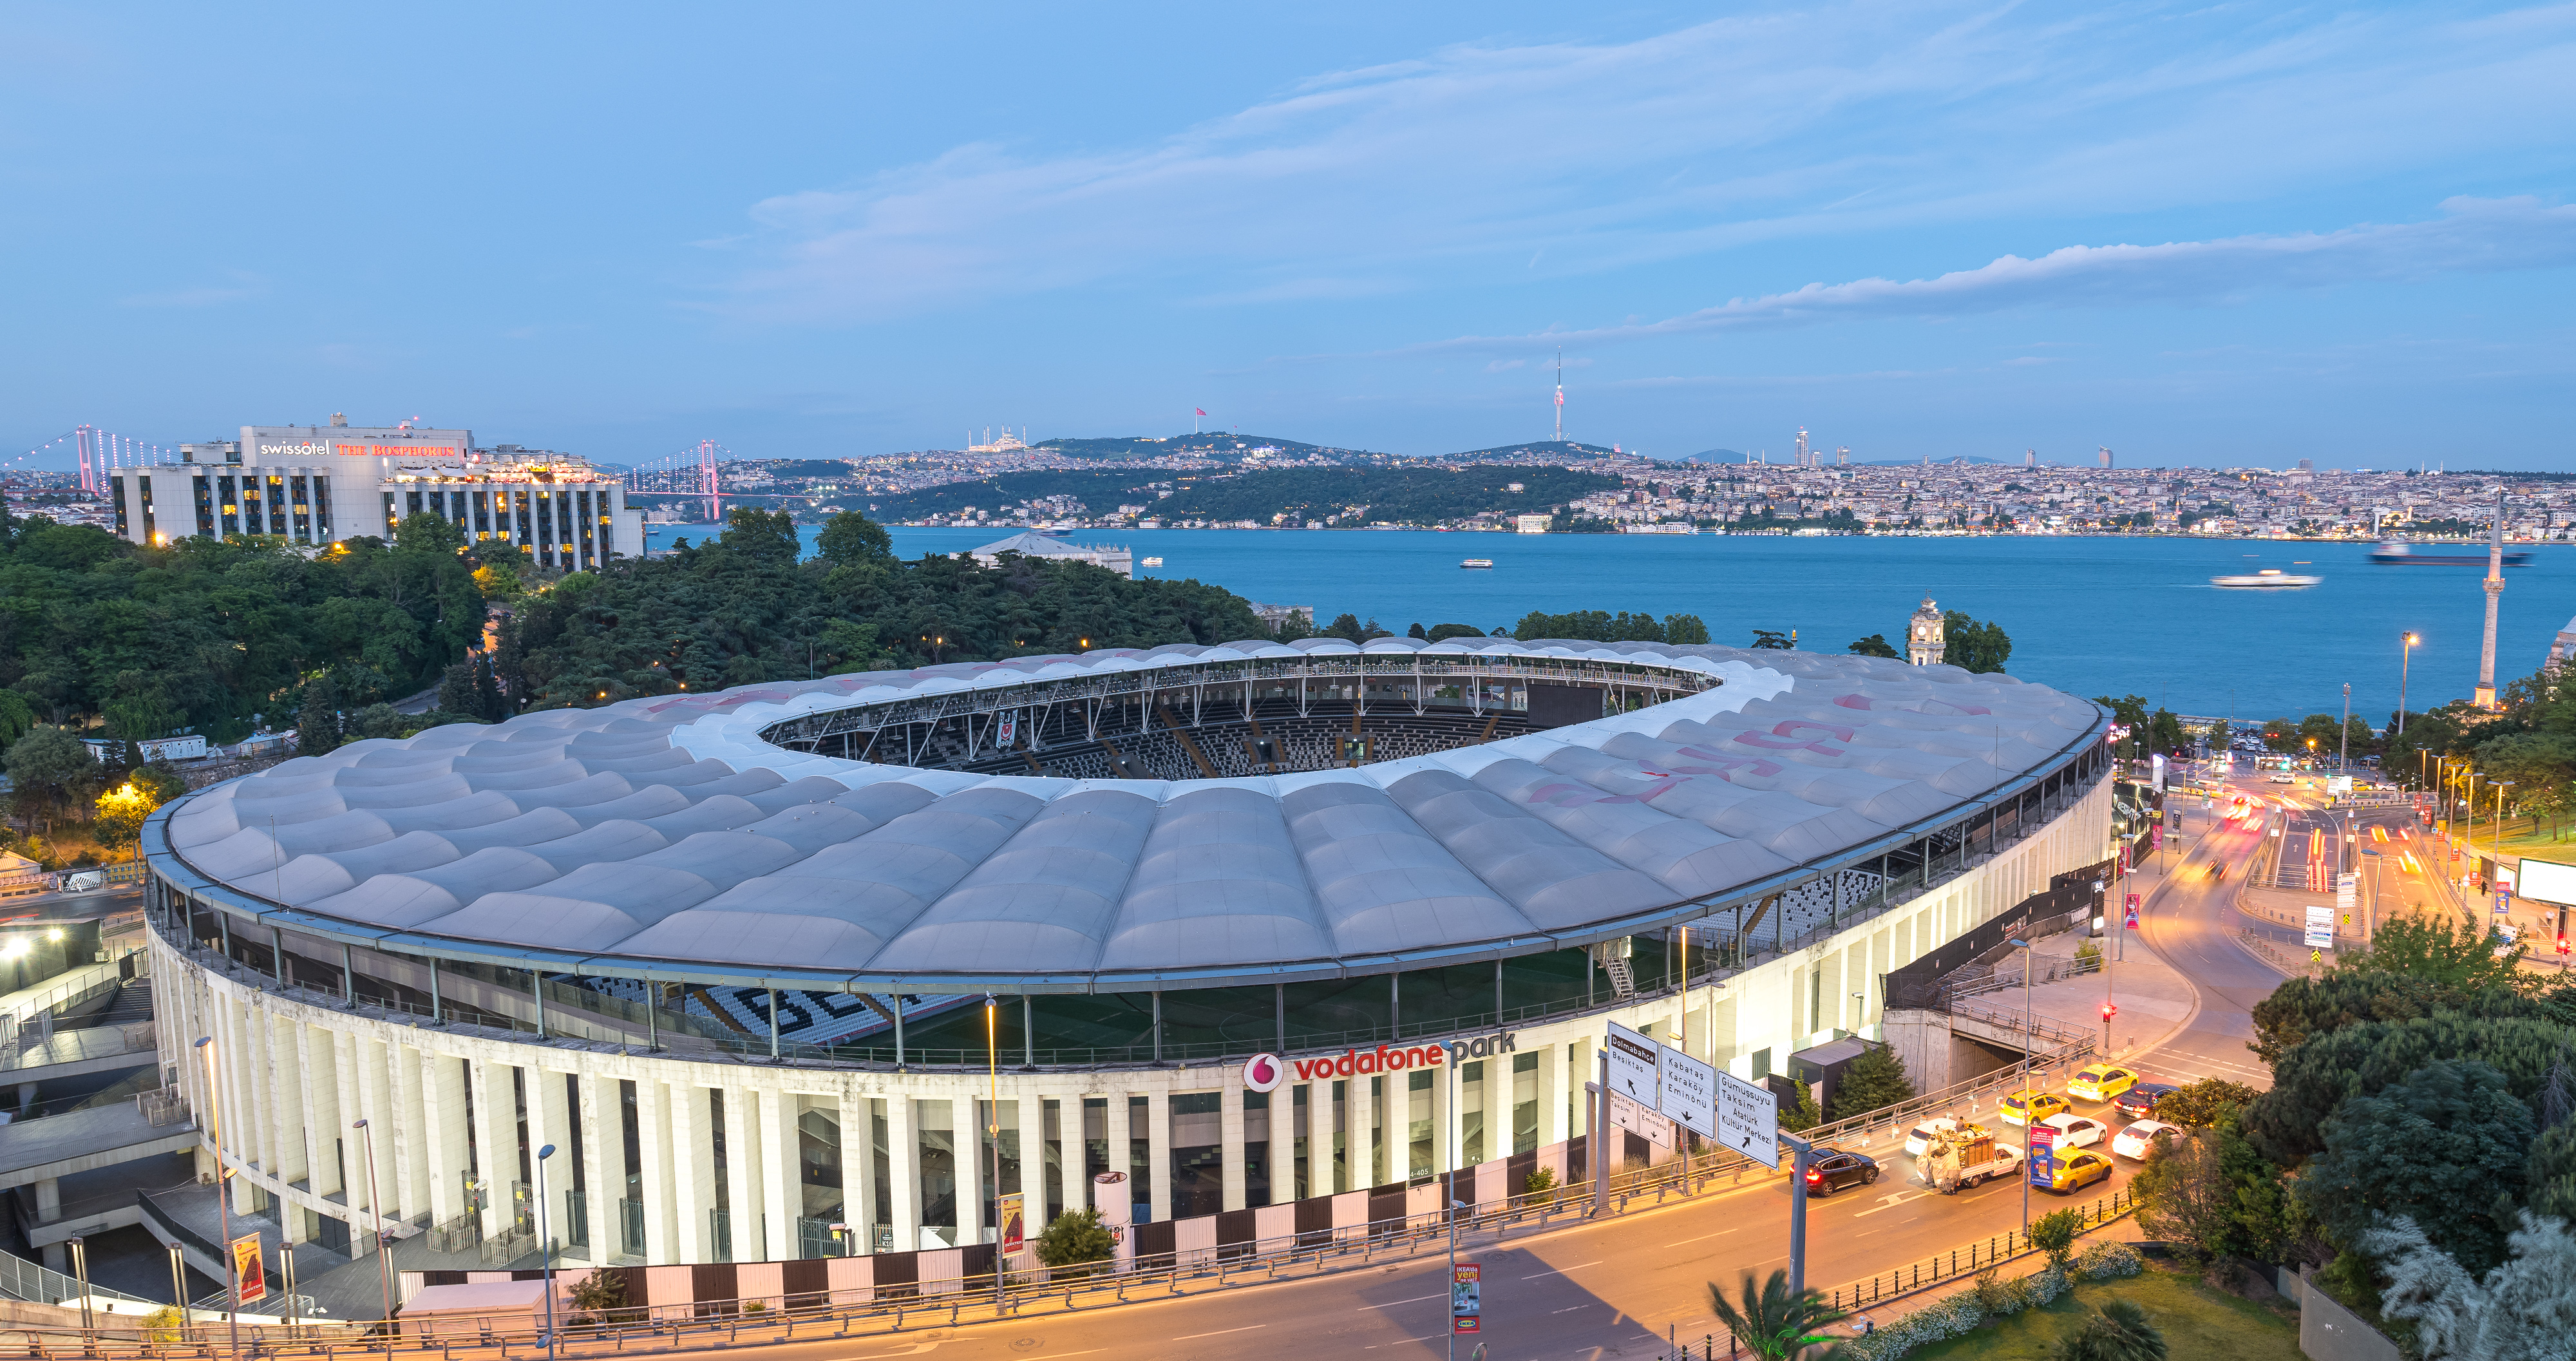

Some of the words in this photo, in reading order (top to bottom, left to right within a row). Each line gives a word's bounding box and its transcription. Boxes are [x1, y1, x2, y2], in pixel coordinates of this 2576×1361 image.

[261, 439, 330, 455] swissôtel
[336, 444, 366, 455] THE
[372, 444, 455, 457] BOSPHORUS
[999, 712, 1017, 723] BJK
[998, 739, 1014, 747] 1903
[1294, 1044, 1443, 1080] vodafone
[1452, 1028, 1516, 1069] park
[1613, 1036, 1654, 1062] Dolmabahçe
[1613, 1051, 1643, 1072] Beşiktaş
[1669, 1057, 1703, 1081] Kabataş
[1669, 1071, 1703, 1095] Karaköy
[1721, 1077, 1770, 1106] Gümüşsuyu
[1611, 1092, 1634, 1107] Beşiktaş
[1668, 1083, 1707, 1109] Eminönü
[1721, 1089, 1755, 1112] Taksim
[1611, 1100, 1630, 1113] Taksim
[1642, 1106, 1665, 1122] Karaköy
[1642, 1115, 1666, 1130] Eminönü
[1733, 1107, 1758, 1127] Atatürk
[1721, 1114, 1743, 1131] Kültür
[1745, 1125, 1772, 1145] Merkezi
[1457, 1271, 1477, 1280] yeni
